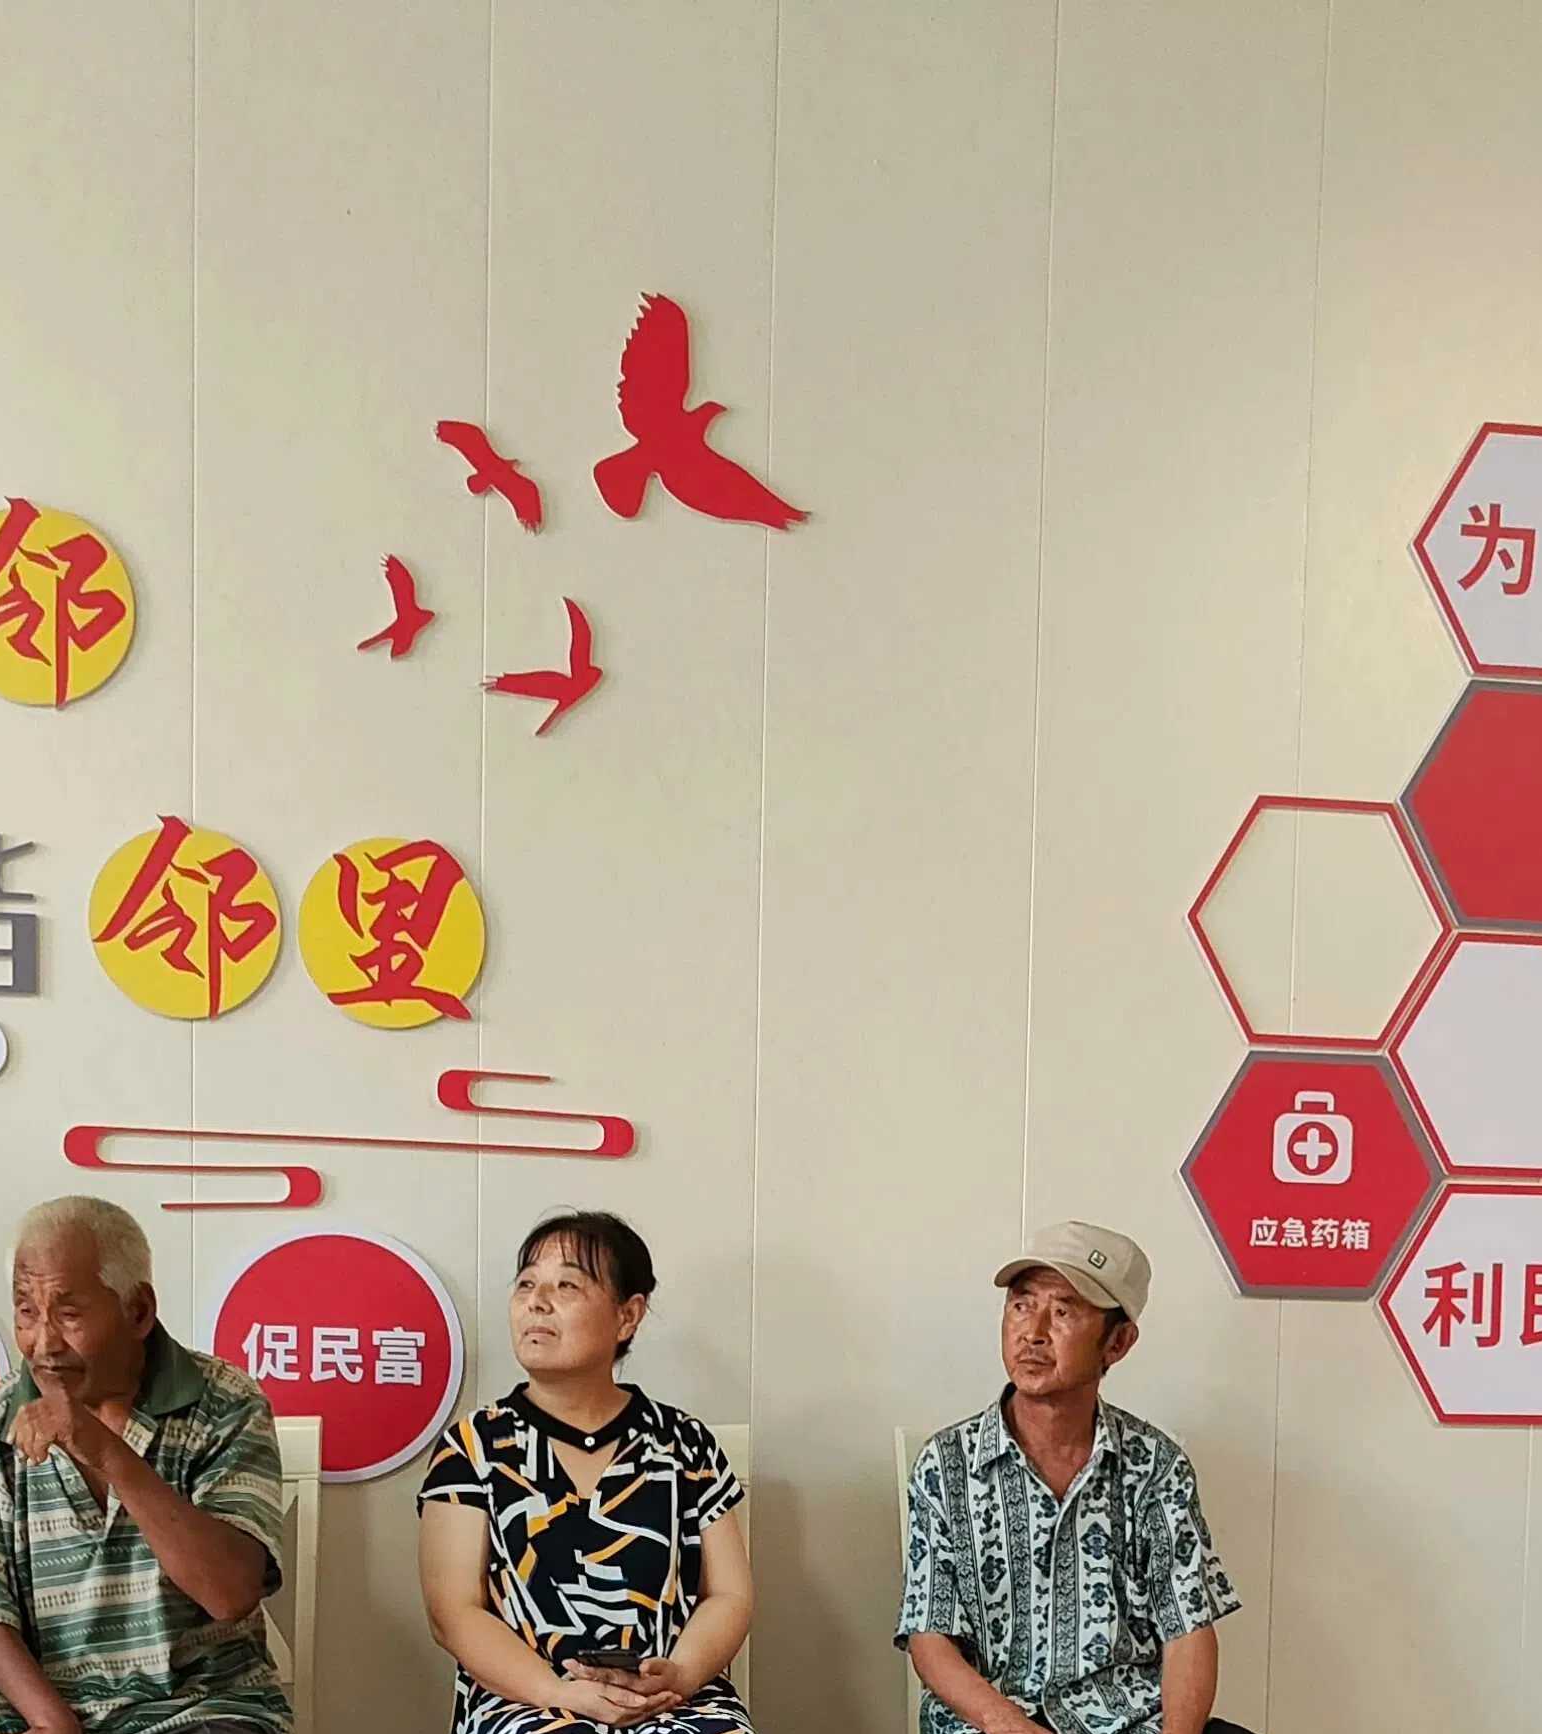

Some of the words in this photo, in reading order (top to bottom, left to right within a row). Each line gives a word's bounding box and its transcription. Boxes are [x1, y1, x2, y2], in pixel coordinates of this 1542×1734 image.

[1249, 1216, 1371, 1250] 应急药箱
[241, 1322, 426, 1386] 促民富
